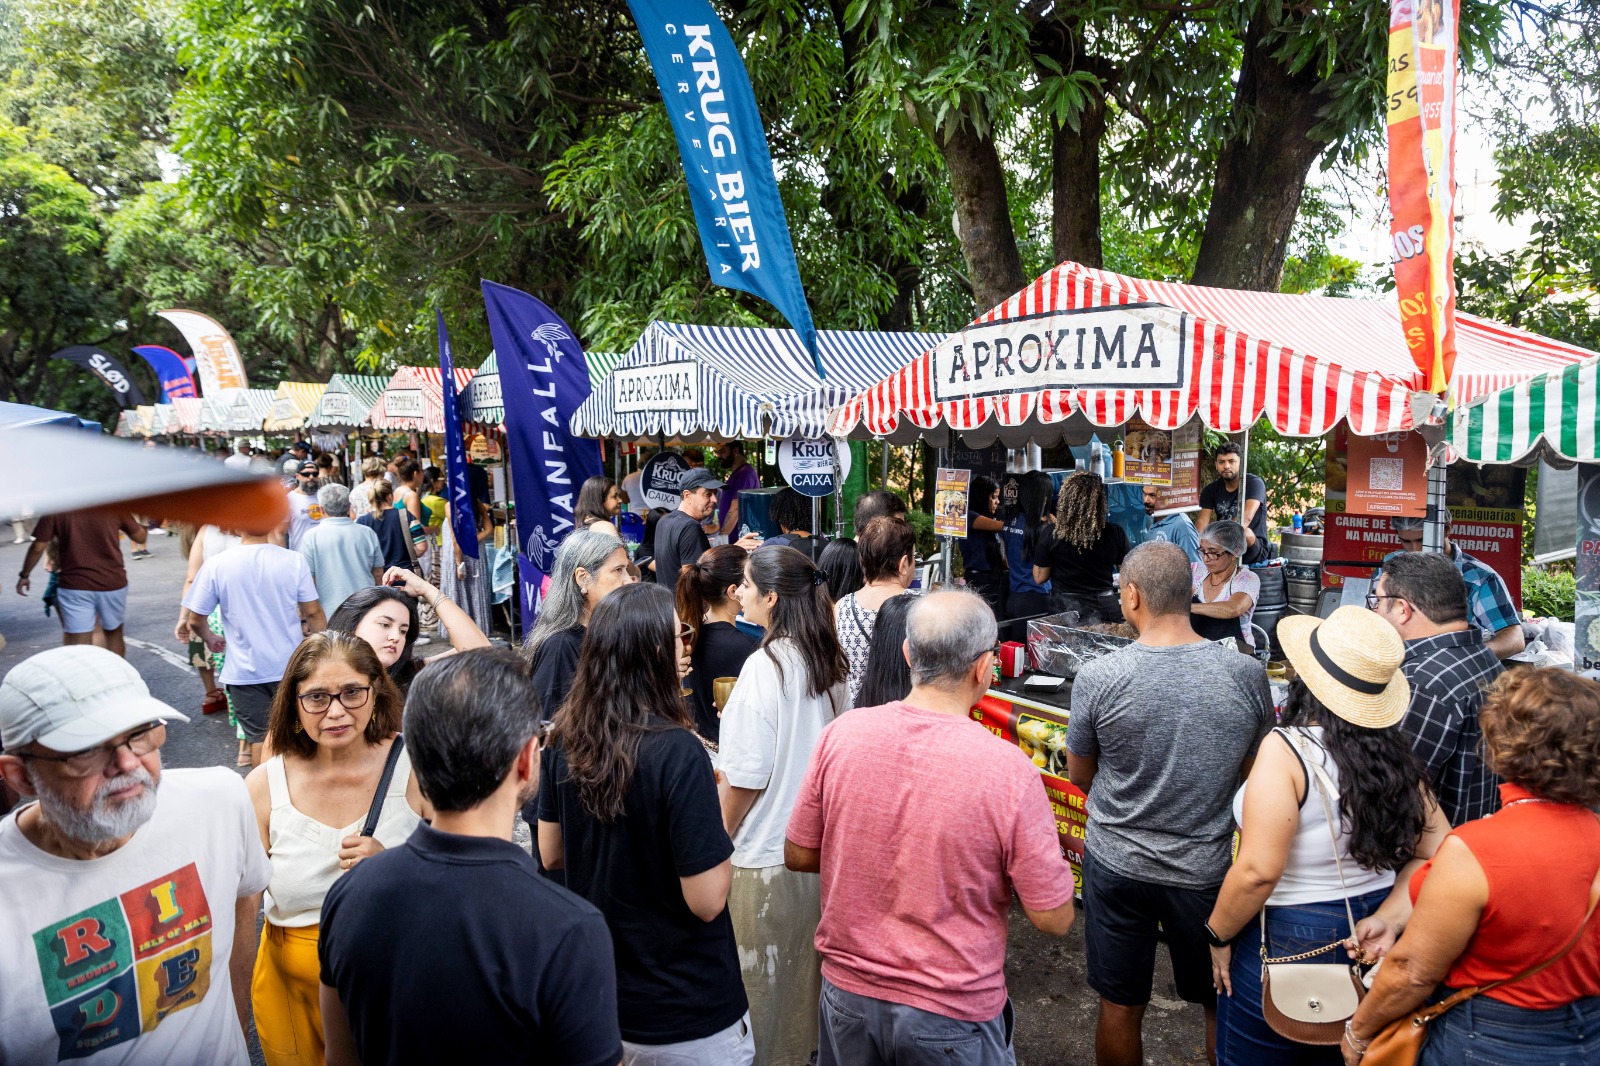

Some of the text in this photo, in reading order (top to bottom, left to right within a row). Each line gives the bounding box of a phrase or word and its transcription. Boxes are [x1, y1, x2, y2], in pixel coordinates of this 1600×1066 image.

[684, 24, 760, 272] KRUG BIER
[949, 322, 1160, 384] APROXIMA
[473, 381, 502, 402] APROX
[619, 372, 692, 403] APROXIMA
[527, 357, 575, 535] VANFALL
[793, 474, 832, 486] CAIXA
[648, 490, 676, 504] CAIXA
[1335, 516, 1369, 528] CARNE
[1372, 518, 1386, 530] DE
[1345, 529, 1402, 545] NA MANTE
[1451, 525, 1514, 538] MANDIOCA
[1068, 791, 1084, 809] DE
[57, 917, 110, 966] R
[139, 914, 209, 952] ISLE OF MAN
[67, 960, 118, 988] RHODES
[161, 948, 200, 997] E
[79, 988, 122, 1029] D
[76, 1028, 120, 1050] DUBLIN
